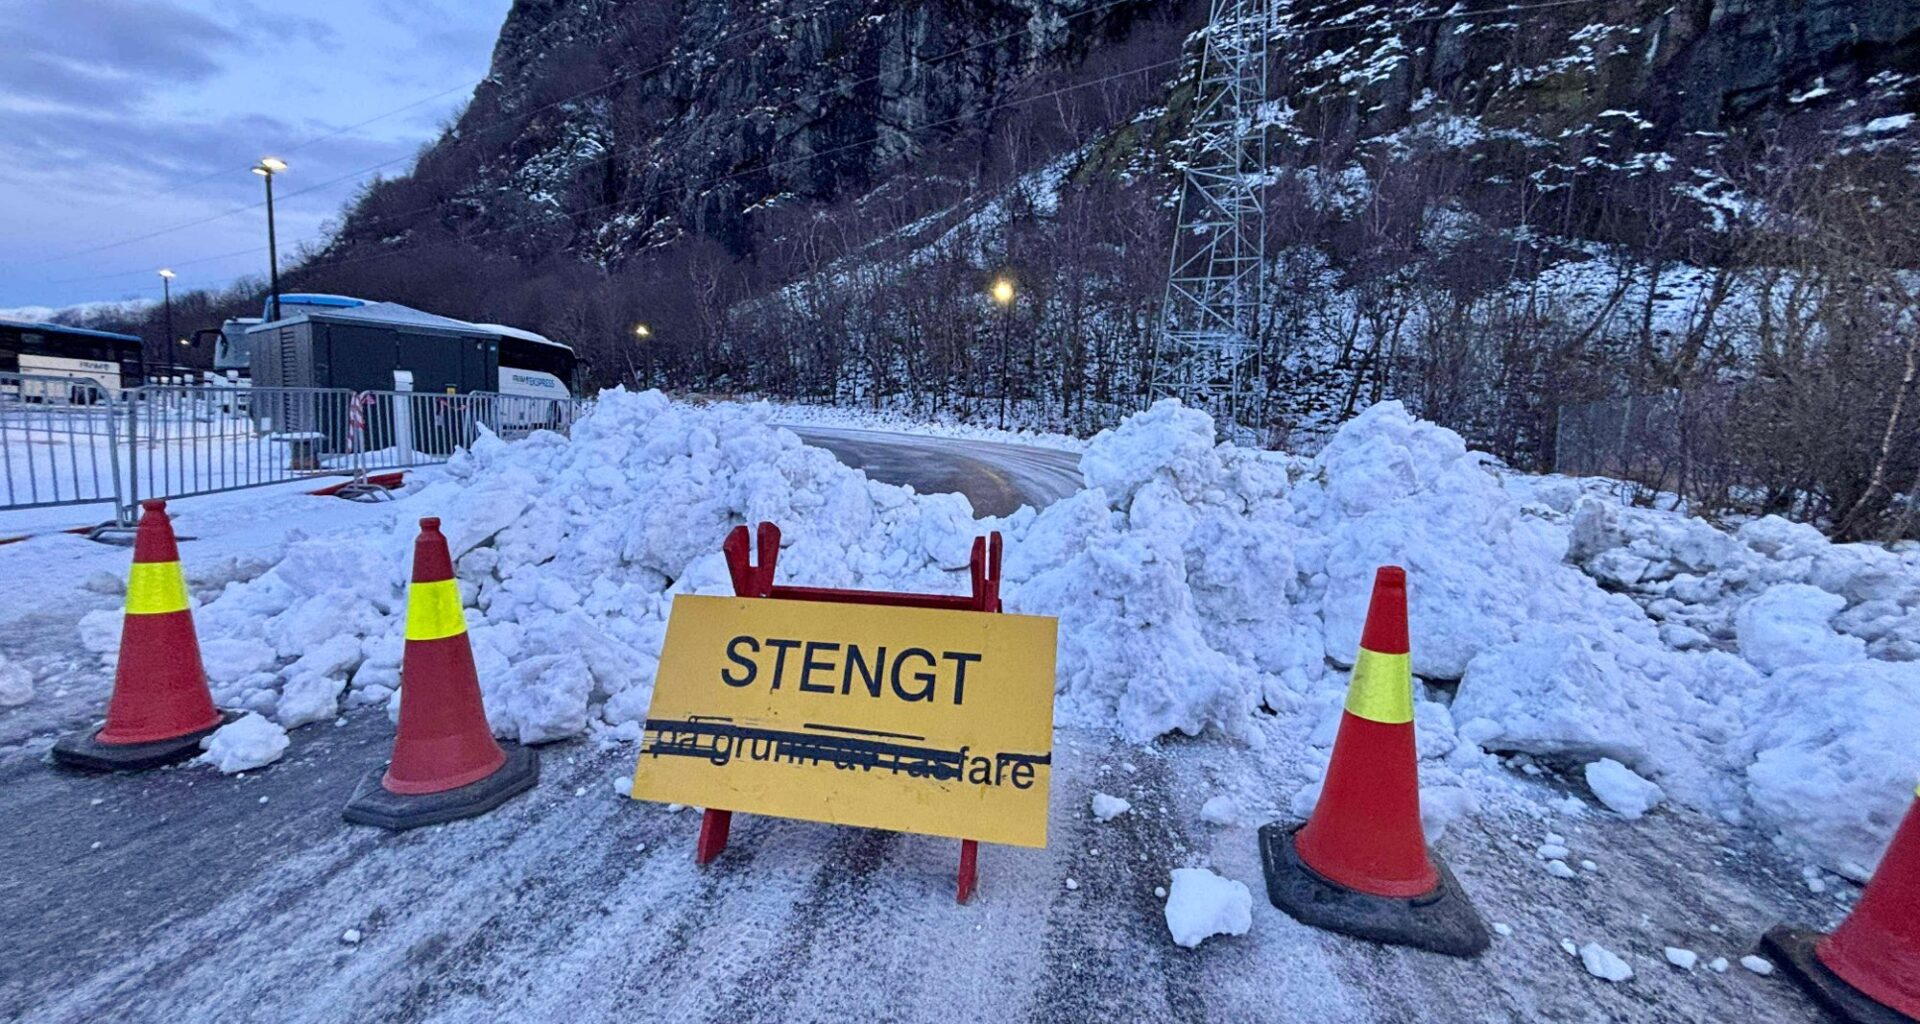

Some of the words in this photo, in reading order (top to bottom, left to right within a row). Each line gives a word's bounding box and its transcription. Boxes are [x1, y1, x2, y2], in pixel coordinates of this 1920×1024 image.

[721, 635, 982, 705] STENGT
[710, 733, 818, 768] gru
[892, 745, 1035, 790] fare
